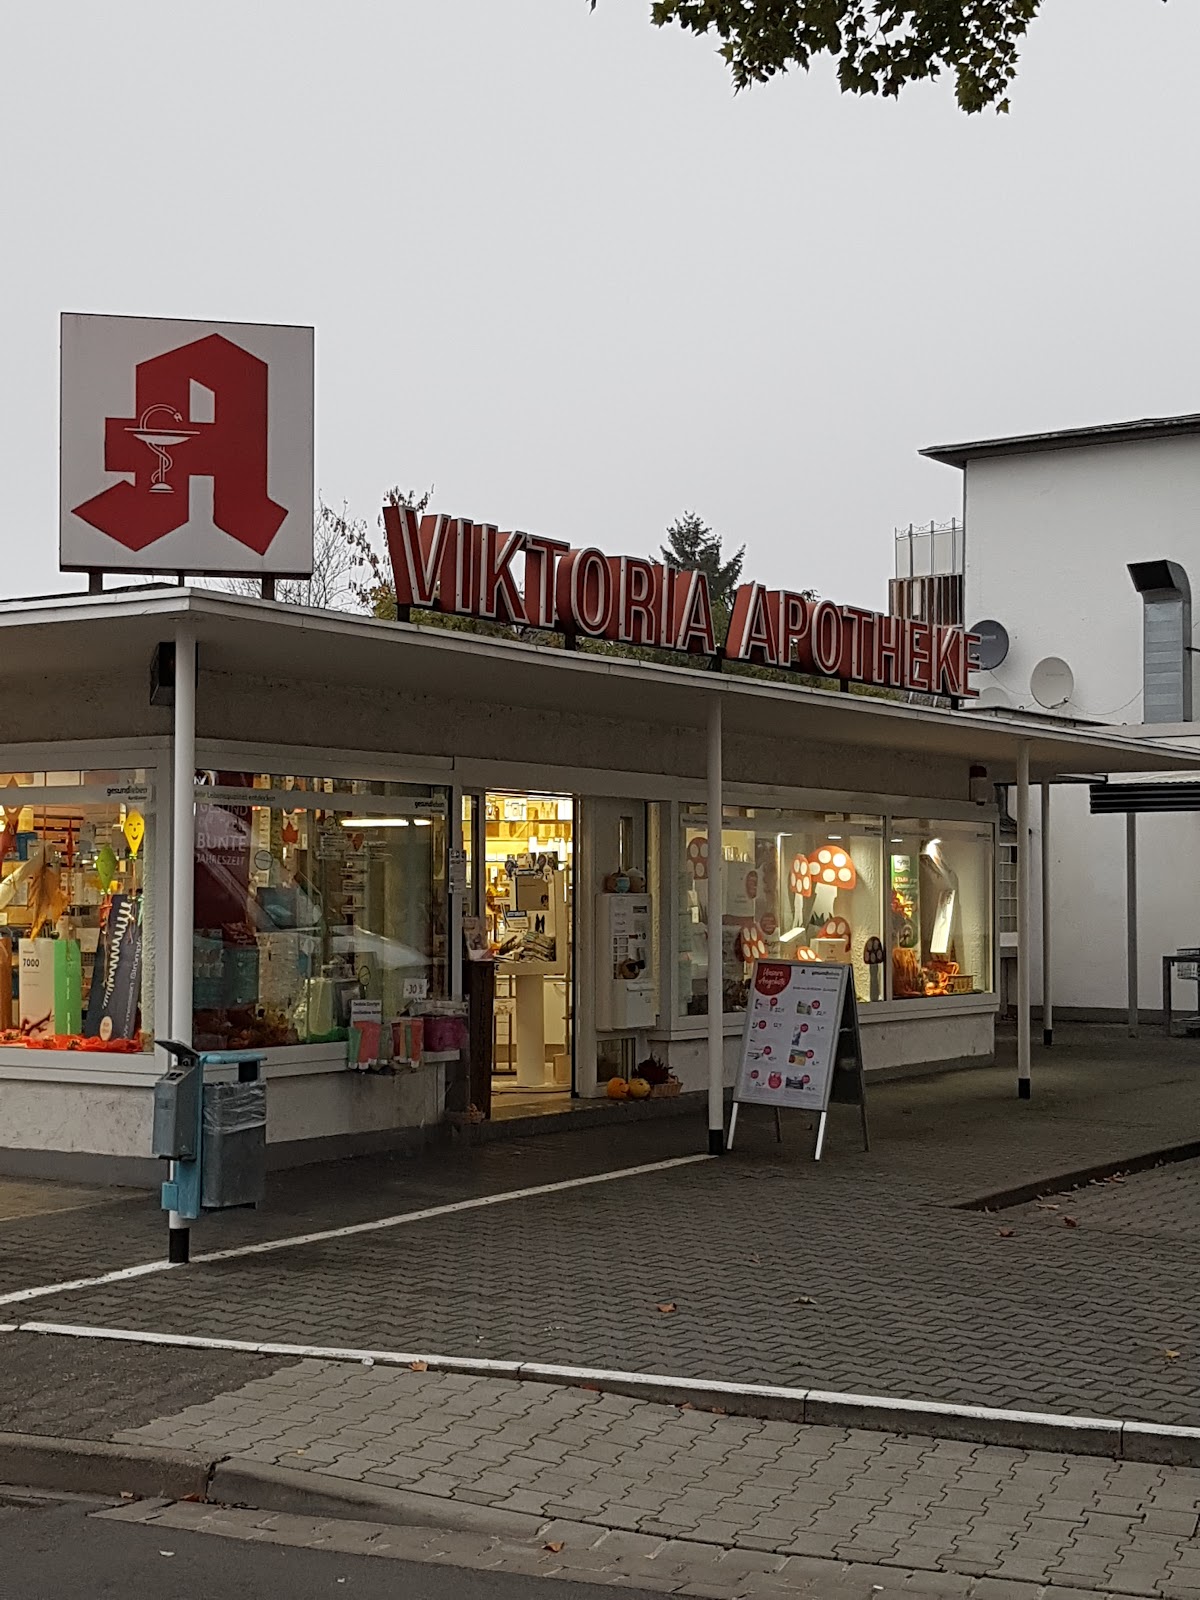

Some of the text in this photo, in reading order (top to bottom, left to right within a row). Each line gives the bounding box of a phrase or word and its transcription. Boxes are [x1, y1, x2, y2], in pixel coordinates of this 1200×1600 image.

[383, 505, 982, 698] VIKTORIA APOTHEKE
[197, 832, 247, 852] BUNTE
[196, 853, 245, 866] JAHRESZEIT
[23, 958, 40, 968] 7000
